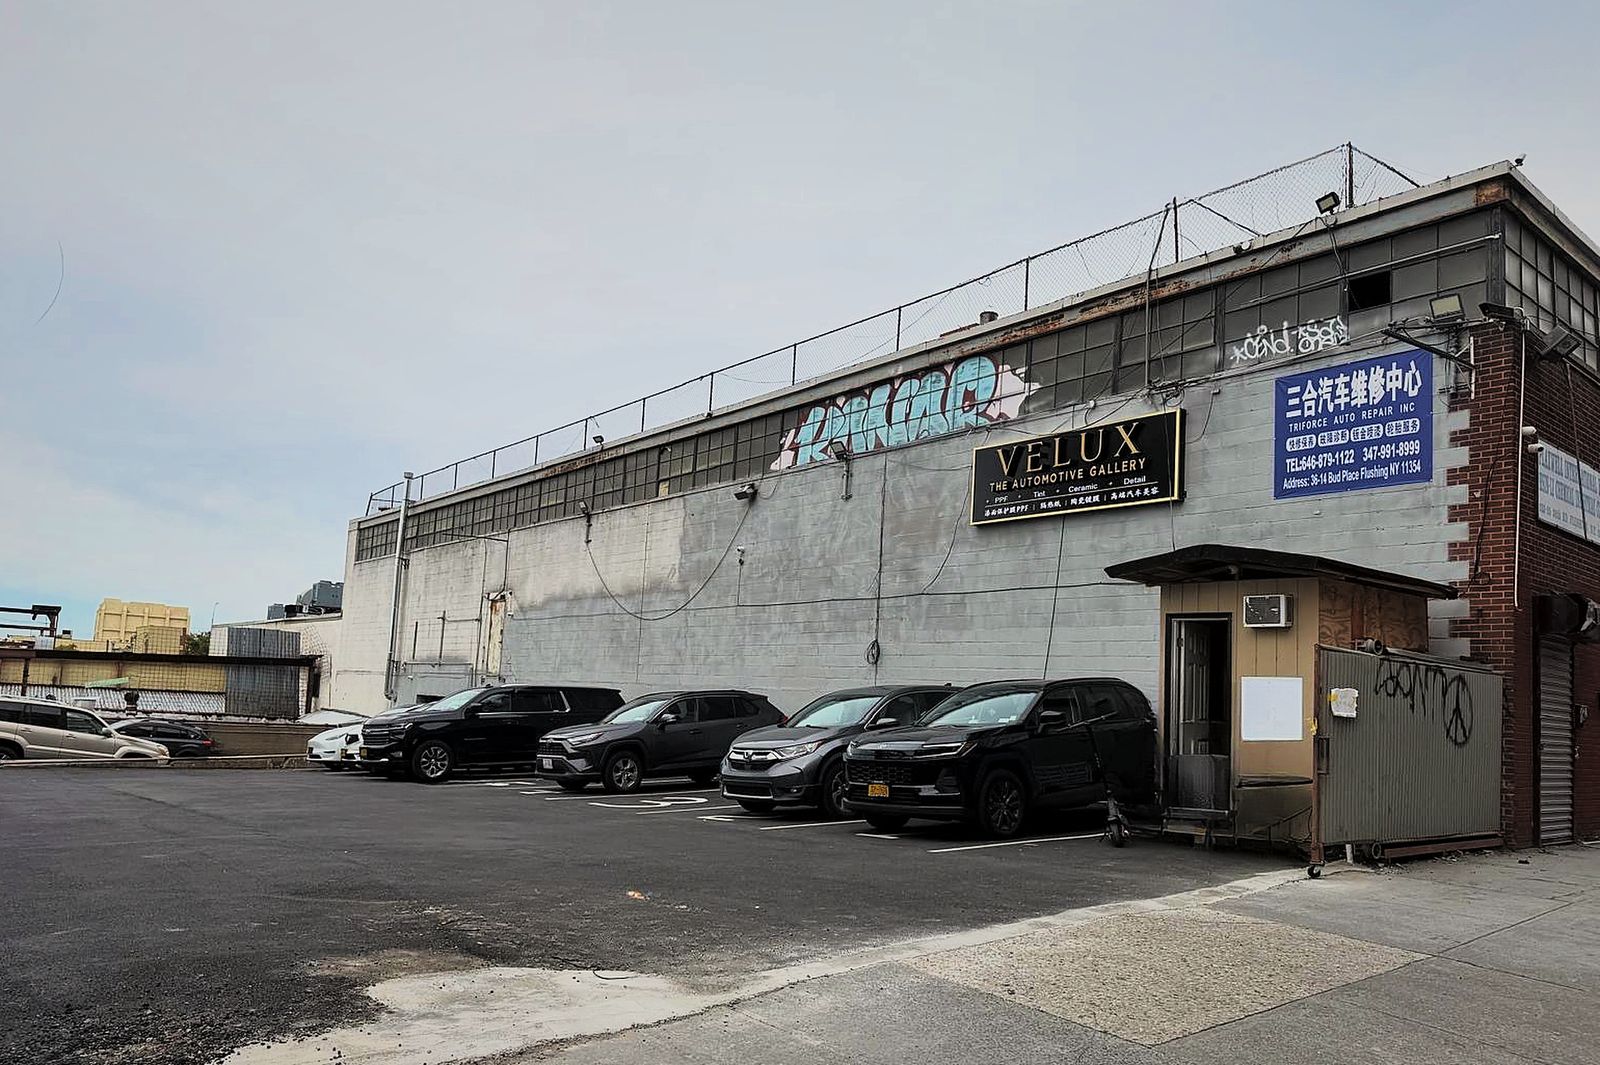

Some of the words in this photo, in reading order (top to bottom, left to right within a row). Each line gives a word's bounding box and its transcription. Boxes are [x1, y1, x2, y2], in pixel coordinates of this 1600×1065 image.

[1286, 360, 1422, 418] 三合汽车维修中心
[1288, 418, 1328, 432] TRIFORCE
[1334, 412, 1356, 425] AUTO
[1362, 406, 1393, 420] REPAIR
[1400, 403, 1415, 413] INC
[996, 422, 1141, 477] VELUX
[1286, 450, 1355, 473] TEL:646-879-1122
[1363, 440, 1420, 462] 347-991-8999
[990, 480, 1007, 492] THE
[1012, 468, 1084, 489] AUTOMOTIVE
[1089, 457, 1146, 476] GALLERY
[994, 496, 1009, 504] PPF
[1033, 490, 1046, 498] Tint
[1068, 482, 1098, 493] Ceramic
[1123, 475, 1146, 485] Detail
[1283, 476, 1310, 490] Address:
[1328, 471, 1341, 483] Bud
[1342, 469, 1359, 481] Place
[1360, 464, 1388, 480] Flushing
[1390, 462, 1400, 474] NY
[1402, 459, 1421, 474] 11354
